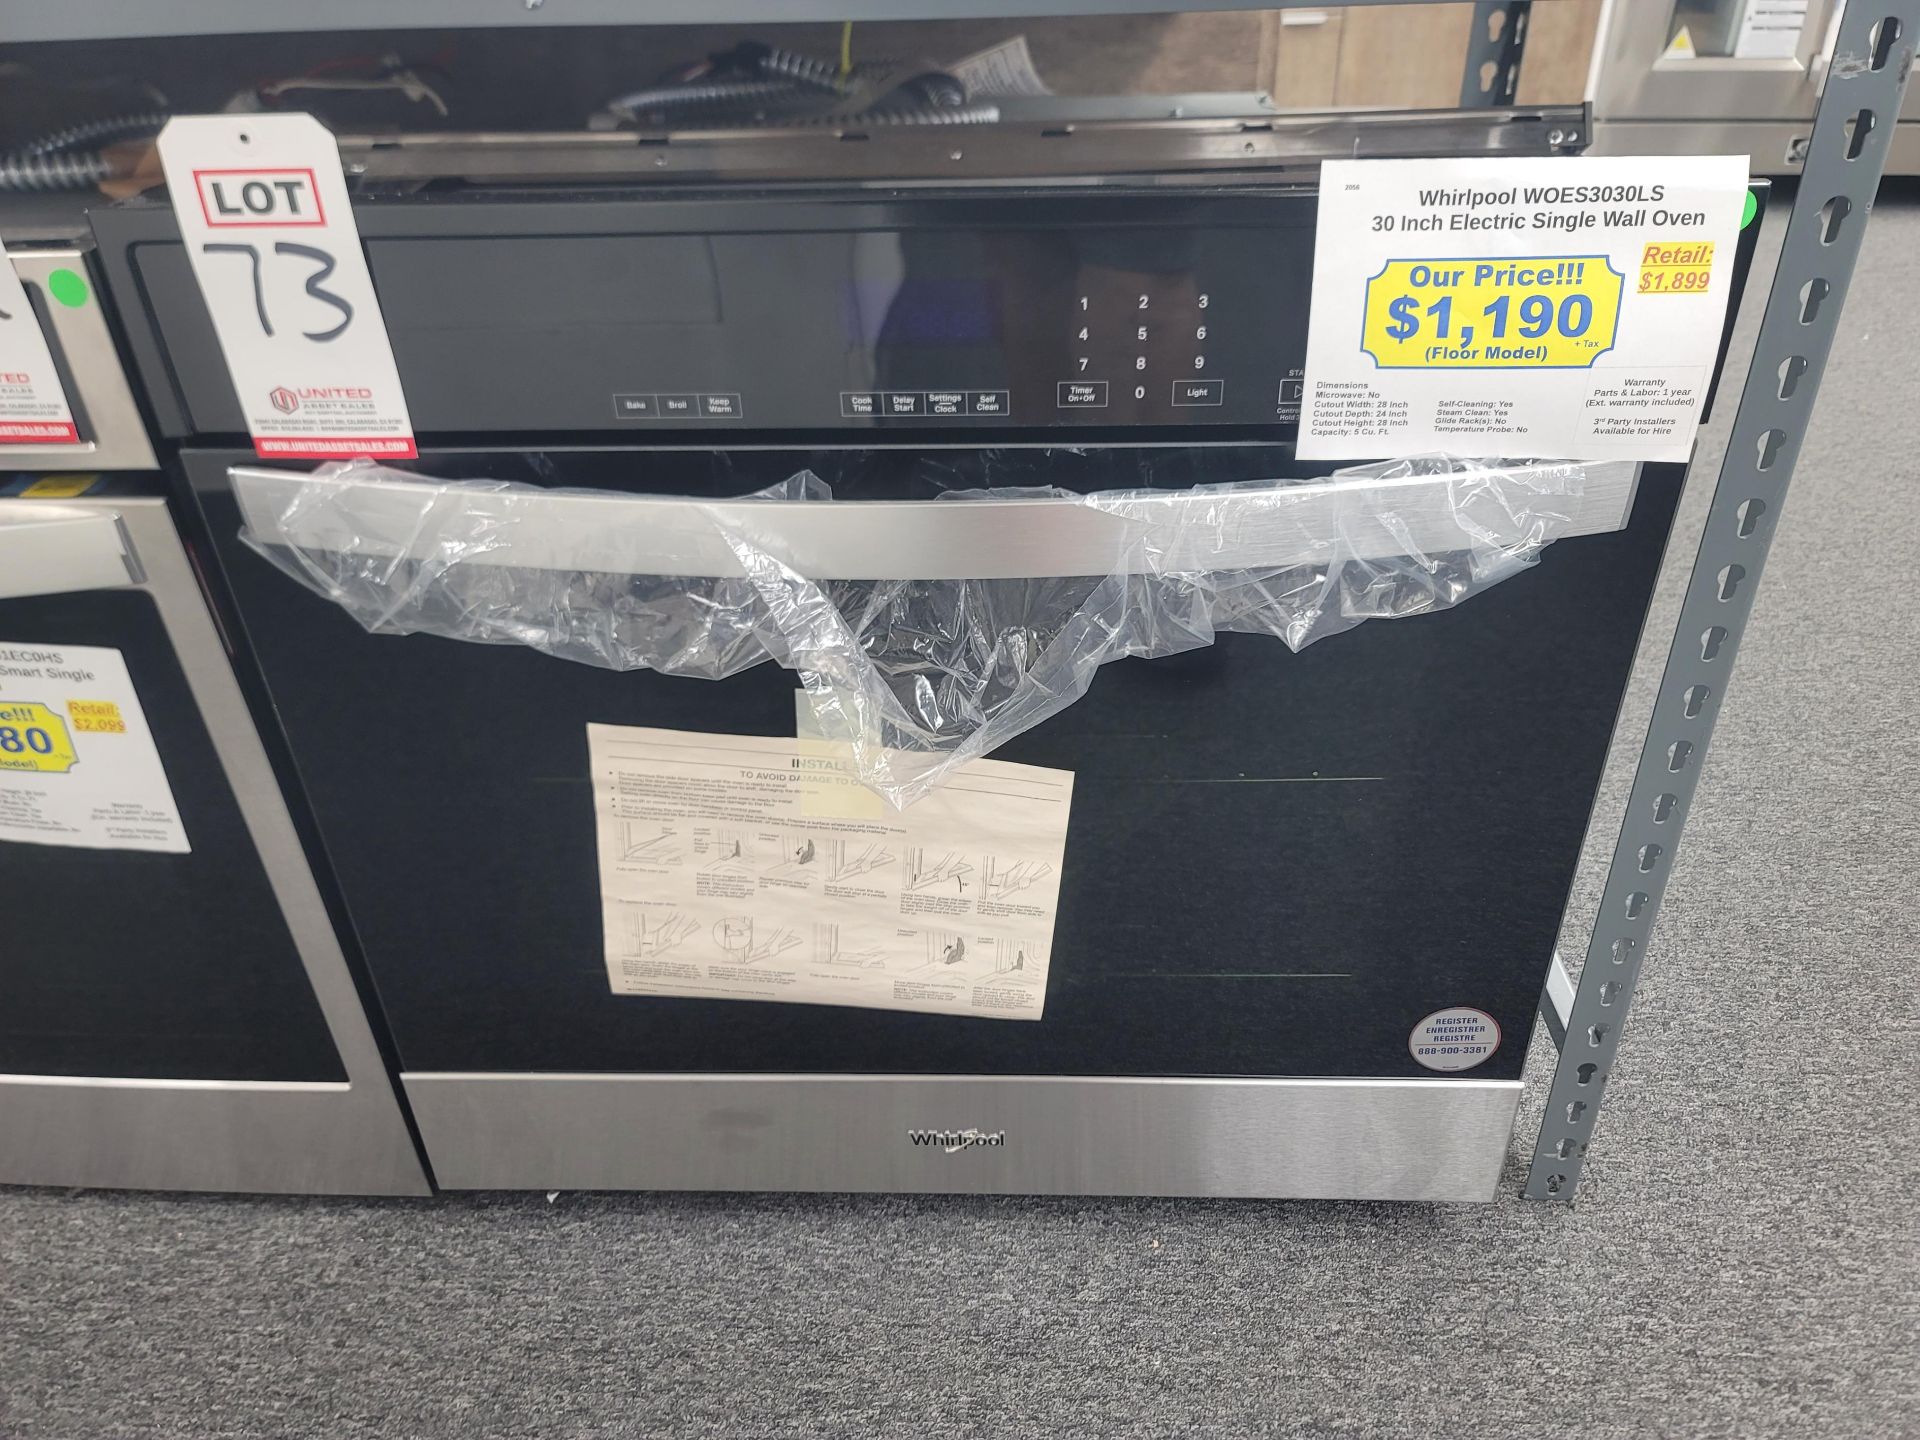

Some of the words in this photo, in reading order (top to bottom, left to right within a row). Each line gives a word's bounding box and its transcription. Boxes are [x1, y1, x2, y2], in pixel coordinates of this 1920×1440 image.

[211, 181, 304, 215] LOT
[1419, 187, 1518, 210] Whirlpool
[1523, 185, 1666, 205] WOES3030LS
[1372, 215, 1395, 232] 30
[1401, 214, 1443, 231] Inch
[1450, 213, 1526, 231] Electric
[1532, 211, 1596, 233] Single
[1603, 210, 1647, 227] Wall
[1652, 209, 1706, 227] Oven
[1642, 245, 1715, 265] Retail:
[1409, 265, 1465, 288] Our
[1474, 263, 1585, 287] Price!!!
[1638, 271, 1711, 292] $1,899
[203, 241, 355, 343] 73
[1080, 297, 1088, 310] 1
[1138, 295, 1149, 309] 2
[1198, 294, 1209, 308] 3
[1385, 294, 1593, 349] $1,190
[1078, 328, 1088, 341] 4
[1137, 327, 1147, 340] 5
[1196, 327, 1206, 340] 6
[1583, 339, 1600, 348] Tax
[1424, 346, 1479, 363] (Floor
[1484, 346, 1548, 362] Model)
[1078, 358, 1088, 371] 7
[1136, 356, 1146, 370] 8
[1194, 356, 1204, 369] 9
[1316, 381, 1369, 389] Dimensions
[1624, 378, 1666, 388] Warranty
[299, 387, 373, 400] UNITED
[1070, 386, 1093, 395] Timer
[1134, 385, 1145, 399] 0
[1187, 388, 1208, 398] Light
[1315, 391, 1366, 399] Microwave:
[1368, 391, 1380, 399] No
[1594, 389, 1618, 397] Parts
[1620, 389, 1628, 397] &
[1630, 388, 1660, 396] Labor:
[1662, 388, 1668, 396] 1
[1670, 389, 1692, 398] year
[708, 398, 730, 407] Keep
[851, 397, 873, 405] Cook
[892, 396, 915, 405] Delay
[928, 394, 962, 403] Settings
[979, 395, 995, 403] Self
[1585, 399, 1606, 408] (Ext.
[1609, 399, 1649, 408] warranty
[1652, 397, 1695, 407] included)
[668, 400, 687, 409] Broil
[708, 405, 732, 413] Warm
[853, 404, 872, 412] Time
[894, 404, 914, 412] Start
[934, 405, 957, 413] Clock
[976, 403, 999, 411] Clean
[1438, 400, 1496, 409] Self-Cleaning:
[1499, 400, 1514, 408] Yes
[1313, 410, 1343, 418] Cutout
[1345, 410, 1373, 418] Depth:
[1375, 410, 1386, 418] 24
[1312, 419, 1342, 427] Cutout
[1343, 419, 1375, 427] Height:
[1458, 417, 1492, 425] Rack(s):
[1607, 418, 1632, 427] Party
[1311, 428, 1351, 437] Capacity:
[1361, 428, 1376, 436] Cu.
[1378, 428, 1389, 436] Ft.
[1433, 425, 1485, 433] Temperature
[1593, 427, 1635, 435] Available
[1636, 427, 1650, 435] for
[1652, 427, 1671, 435] Hire
[0, 664, 43, 678] Smart
[46, 667, 96, 683] Single
[68, 702, 120, 717] Retail:
[740, 770, 754, 779] TO
[756, 772, 787, 782] AVOID
[788, 774, 832, 785] DAMAGE
[834, 777, 849, 786] TO
[1435, 1017, 1478, 1025] REGISTER
[1426, 1025, 1486, 1034] ENREGISTRER
[1433, 1034, 1476, 1042] REGISTRE
[1417, 1046, 1487, 1056] 888-900-3381
[908, 1129, 1006, 1151] Whirlpool
